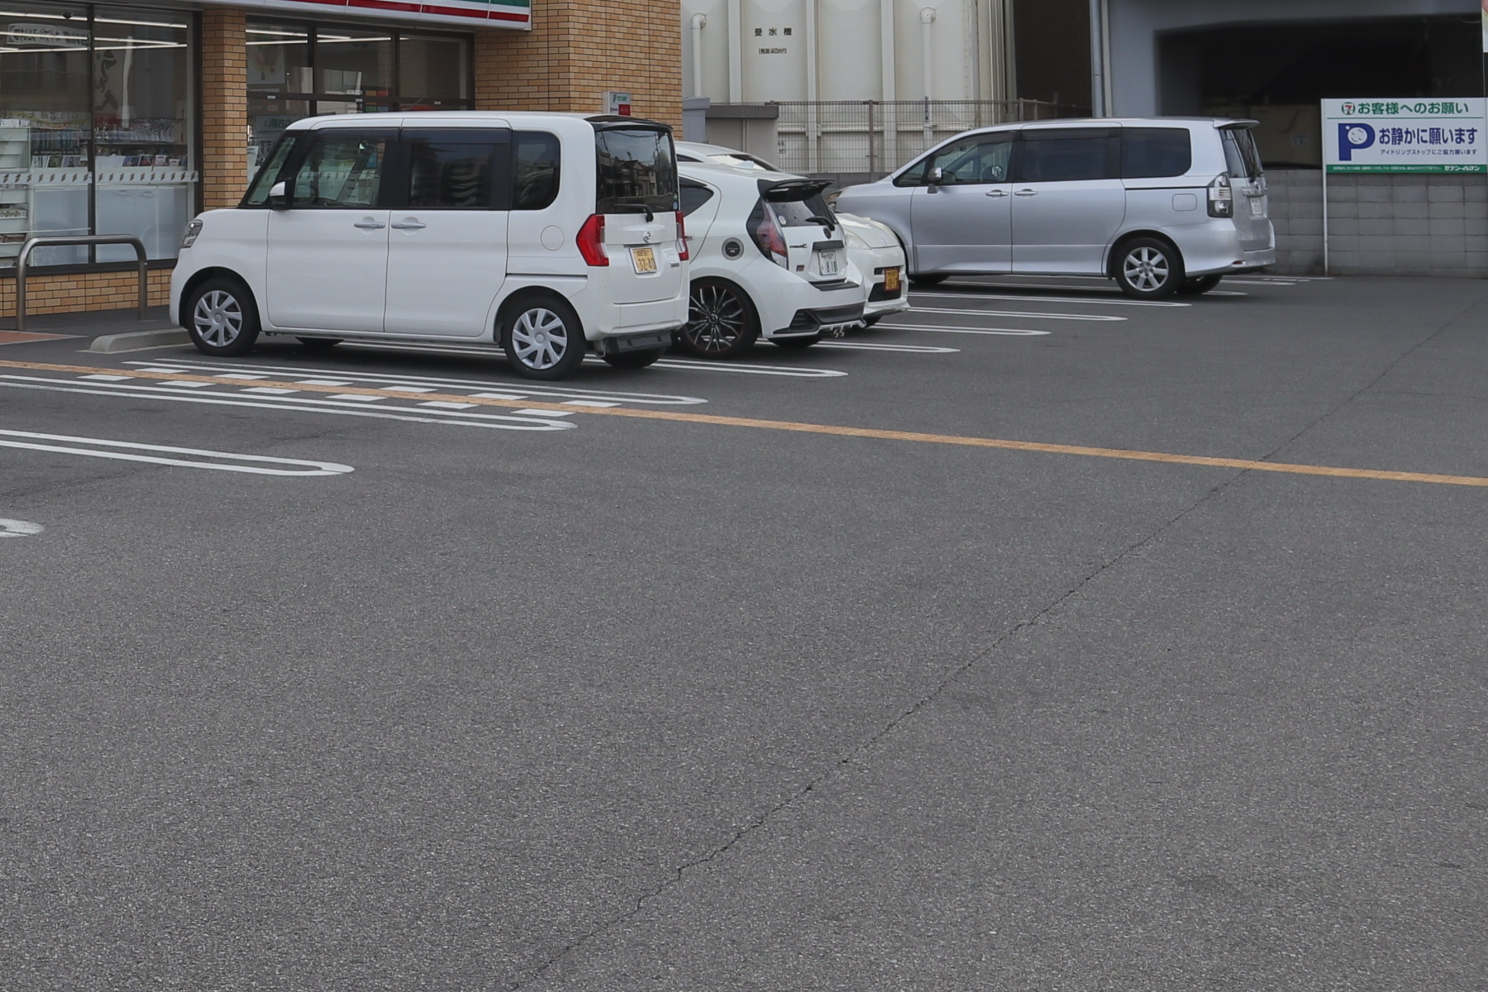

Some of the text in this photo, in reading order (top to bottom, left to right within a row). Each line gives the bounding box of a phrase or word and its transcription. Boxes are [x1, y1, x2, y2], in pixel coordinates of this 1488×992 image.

[1358, 102, 1469, 115] お客様へのお願い
[1338, 123, 1376, 161] P
[1379, 127, 1478, 145] お静かに願います
